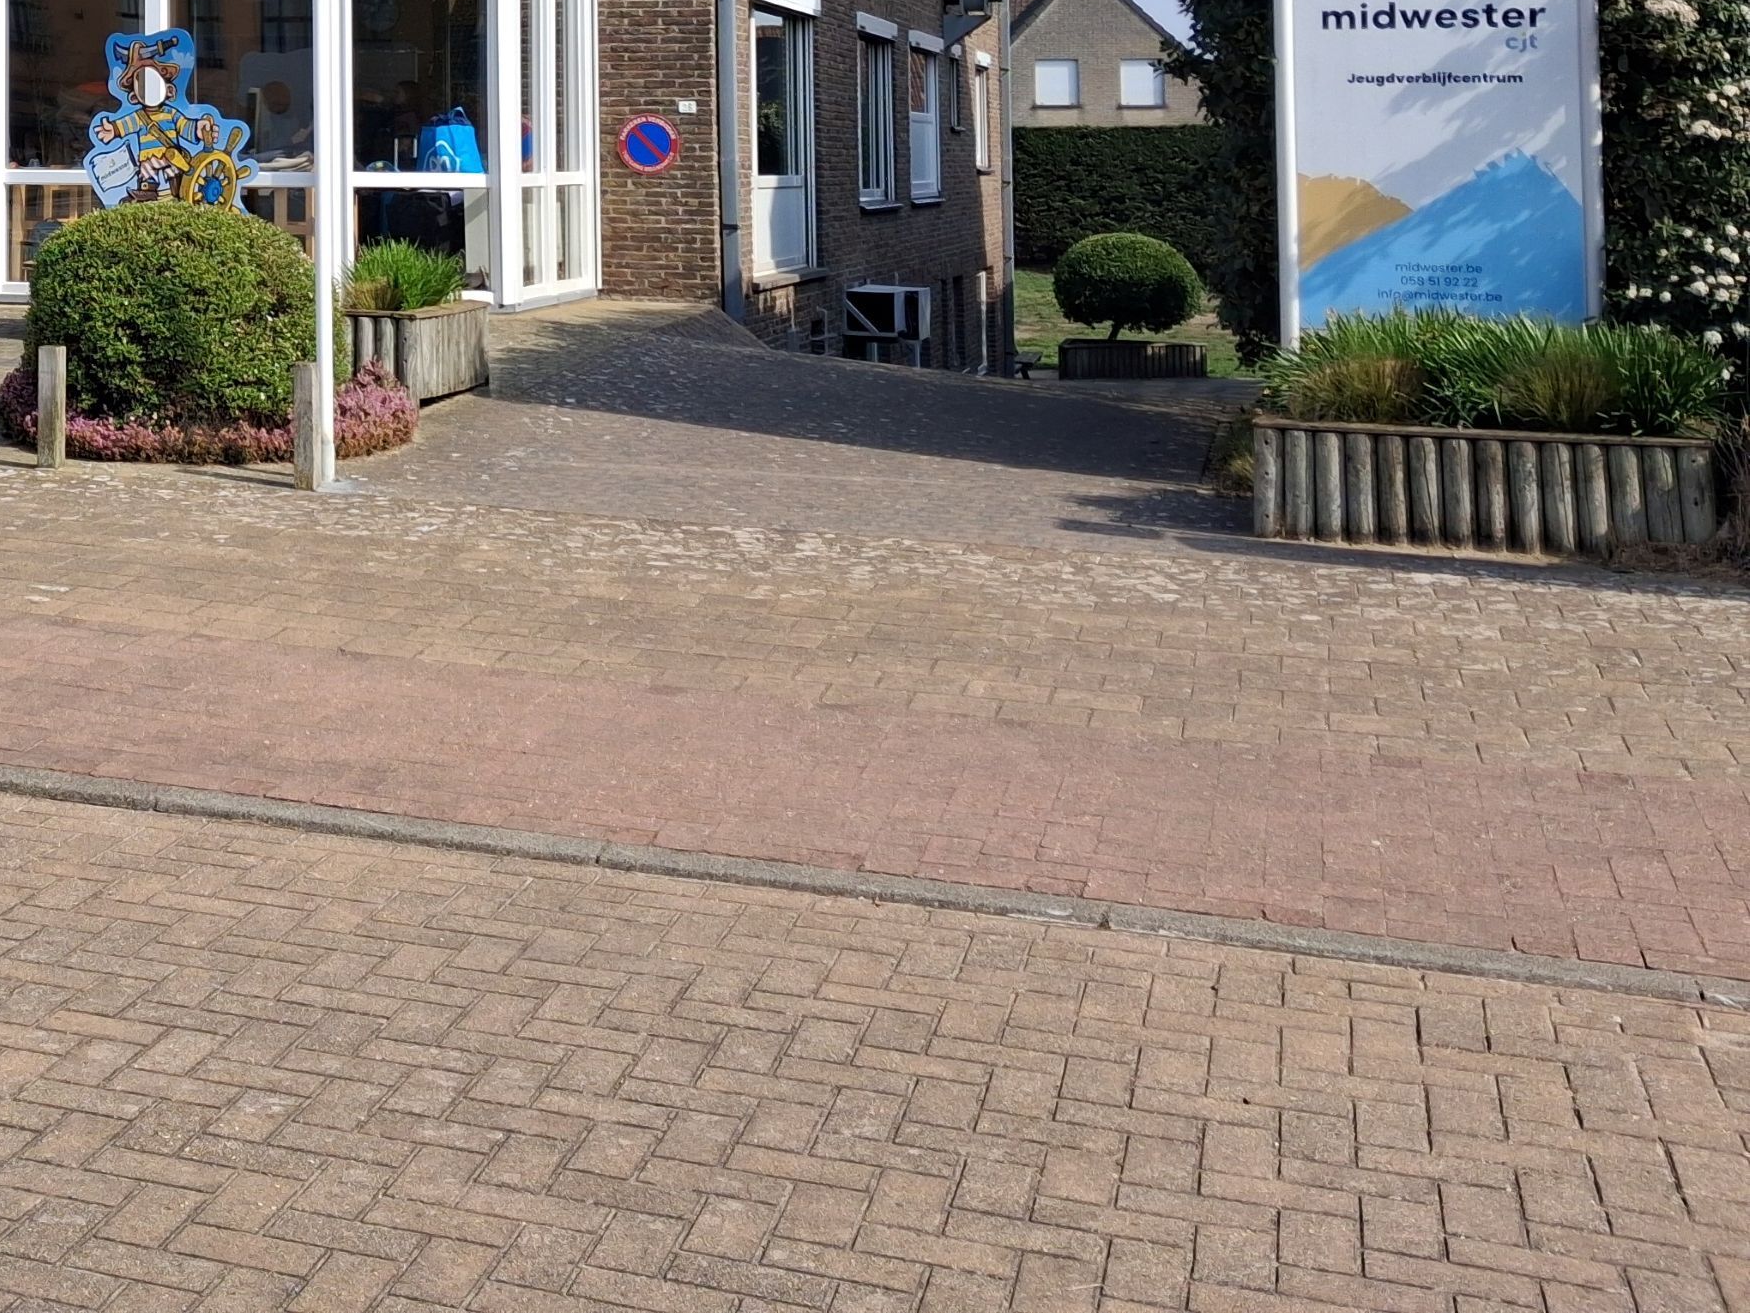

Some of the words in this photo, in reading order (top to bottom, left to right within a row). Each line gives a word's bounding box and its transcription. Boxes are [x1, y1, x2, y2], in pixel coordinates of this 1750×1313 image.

[1321, 2, 1547, 30] midwester
[1504, 31, 1538, 53] cjt
[1347, 71, 1524, 87] Jeugdverblijfcentrum
[1395, 262, 1483, 274] midwester.be
[1444, 277, 1460, 287] 92
[1463, 277, 1479, 288] 22
